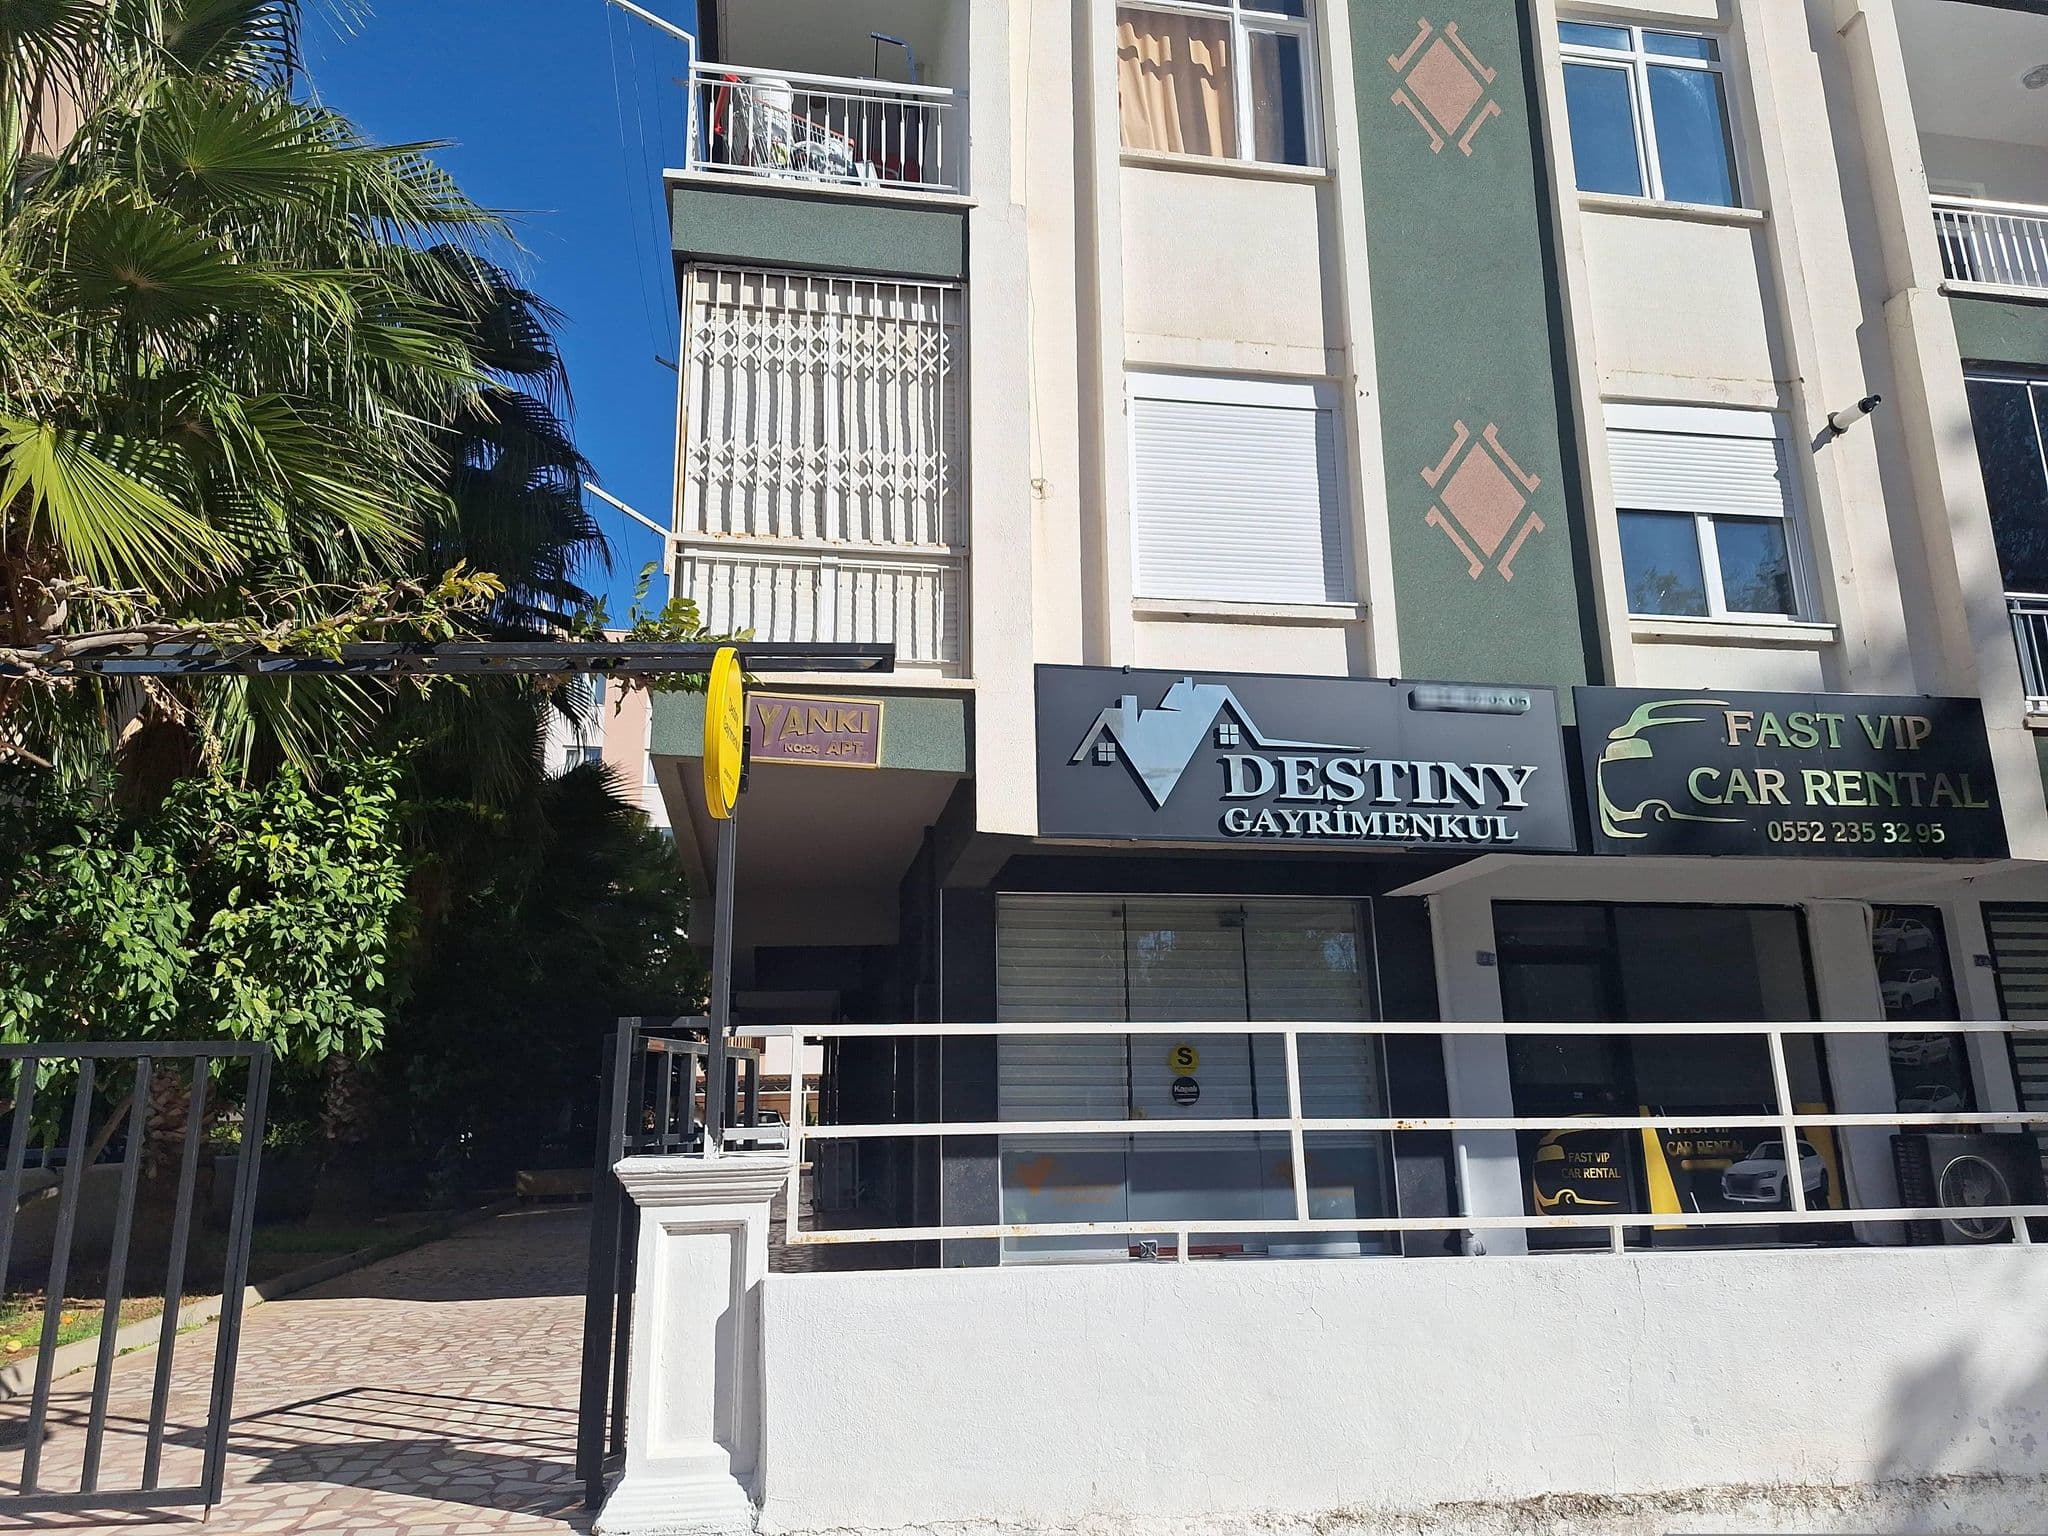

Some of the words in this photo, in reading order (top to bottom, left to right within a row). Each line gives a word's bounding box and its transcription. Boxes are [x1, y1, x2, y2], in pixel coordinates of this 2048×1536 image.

[757, 703, 869, 747] YANKI
[1721, 710, 1845, 749] FAST
[1856, 714, 1932, 750] VIP
[1220, 754, 1538, 807] DESTINY
[1686, 766, 1791, 806] CAR
[1801, 768, 1990, 808] RENTAL
[1222, 803, 1520, 841] GAYRİMENKUL
[1766, 820, 1826, 844] 0552
[1830, 821, 1877, 844] 235
[1882, 822, 1912, 845] 32
[1915, 823, 1946, 845] 95
[1177, 1047, 1193, 1065] S
[1561, 1168, 1582, 1179] CAR
[1583, 1167, 1622, 1179] RENTAL
[1568, 1152, 1593, 1163] FAST
[1594, 1152, 1611, 1163] VIP
